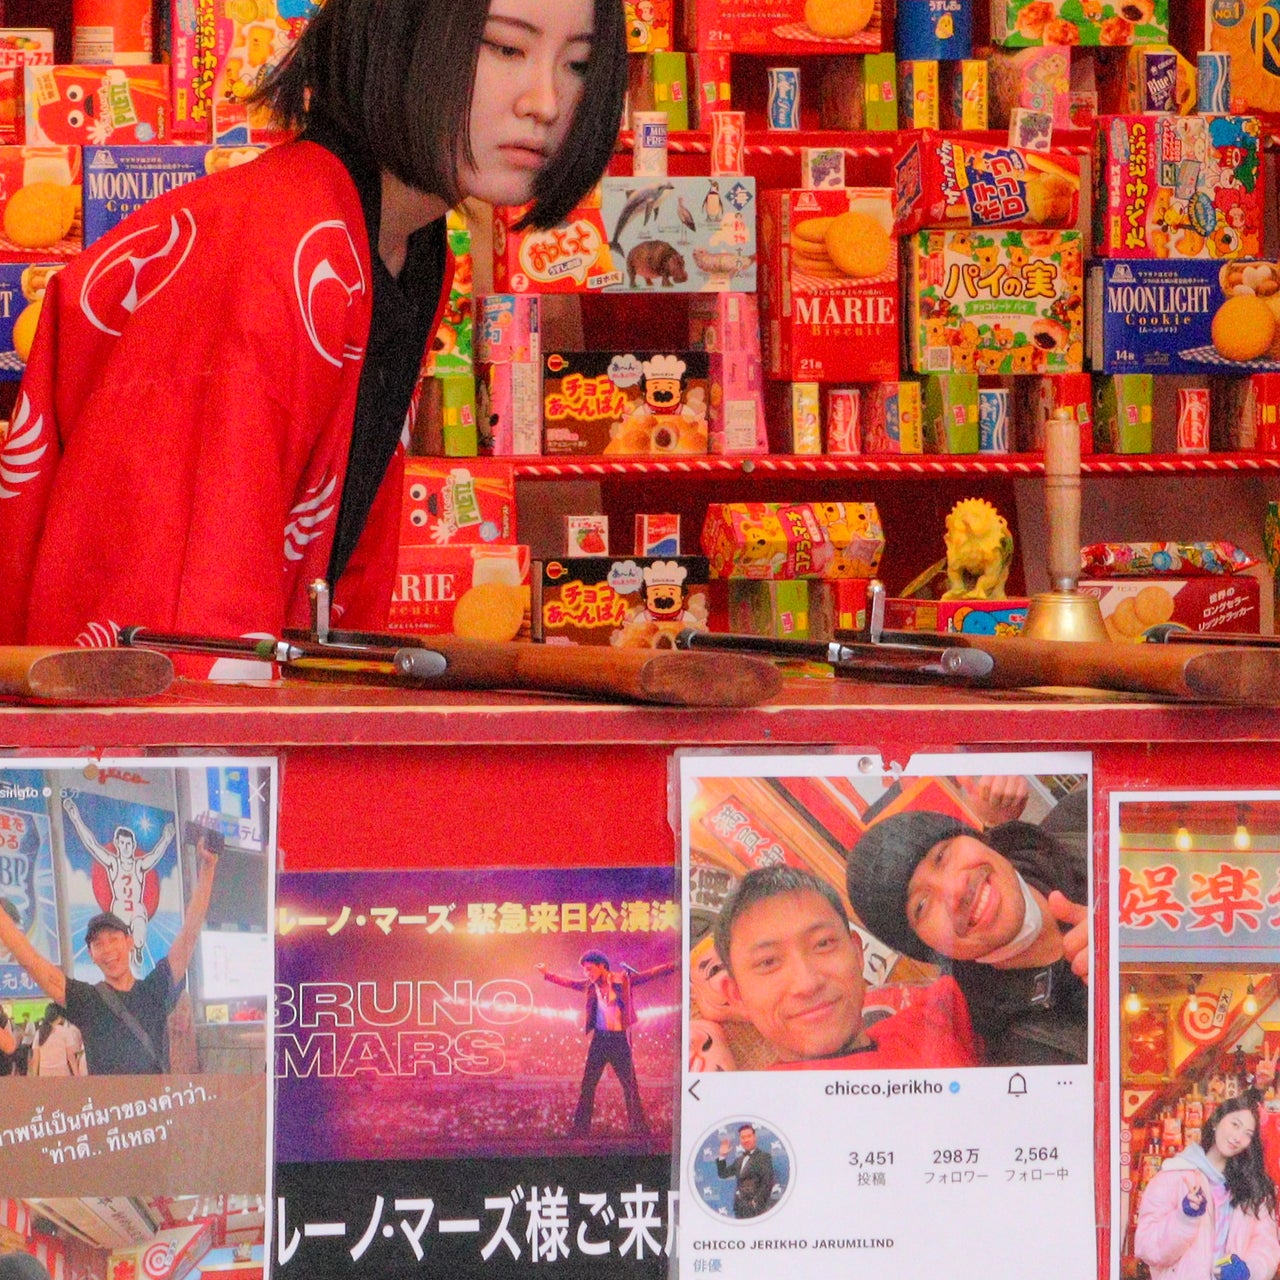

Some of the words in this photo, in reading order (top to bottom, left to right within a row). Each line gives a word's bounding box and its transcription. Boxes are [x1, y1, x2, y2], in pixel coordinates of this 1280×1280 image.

[990, 156, 1024, 216] ロング
[1125, 123, 1148, 249] たべっ子どうぶつ
[973, 183, 1001, 220] ポテ
[527, 225, 591, 272] おっとっと
[945, 260, 1057, 298] パイの実
[795, 297, 894, 325] MARIE
[1126, 314, 1191, 325] Cookie
[565, 375, 614, 396] チョコ
[564, 584, 612, 604] チョコ
[121, 874, 135, 912] グリコ
[275, 979, 534, 1028] BRUNO
[275, 1031, 506, 1078] MARS
[825, 1080, 943, 1097] chicco.jerikho
[849, 1151, 895, 1166] 3,451
[933, 1148, 979, 1164] 298万
[1015, 1146, 1059, 1163] 2,564
[857, 1172, 886, 1186] 投稿
[925, 1171, 989, 1184] フォロワー
[1005, 1168, 1069, 1182] フォロー中
[693, 1240, 745, 1250] CHICCO
[750, 1239, 808, 1250] JERIKHO
[813, 1238, 895, 1249] JARUMILIND
[693, 1258, 722, 1273] 俳優
